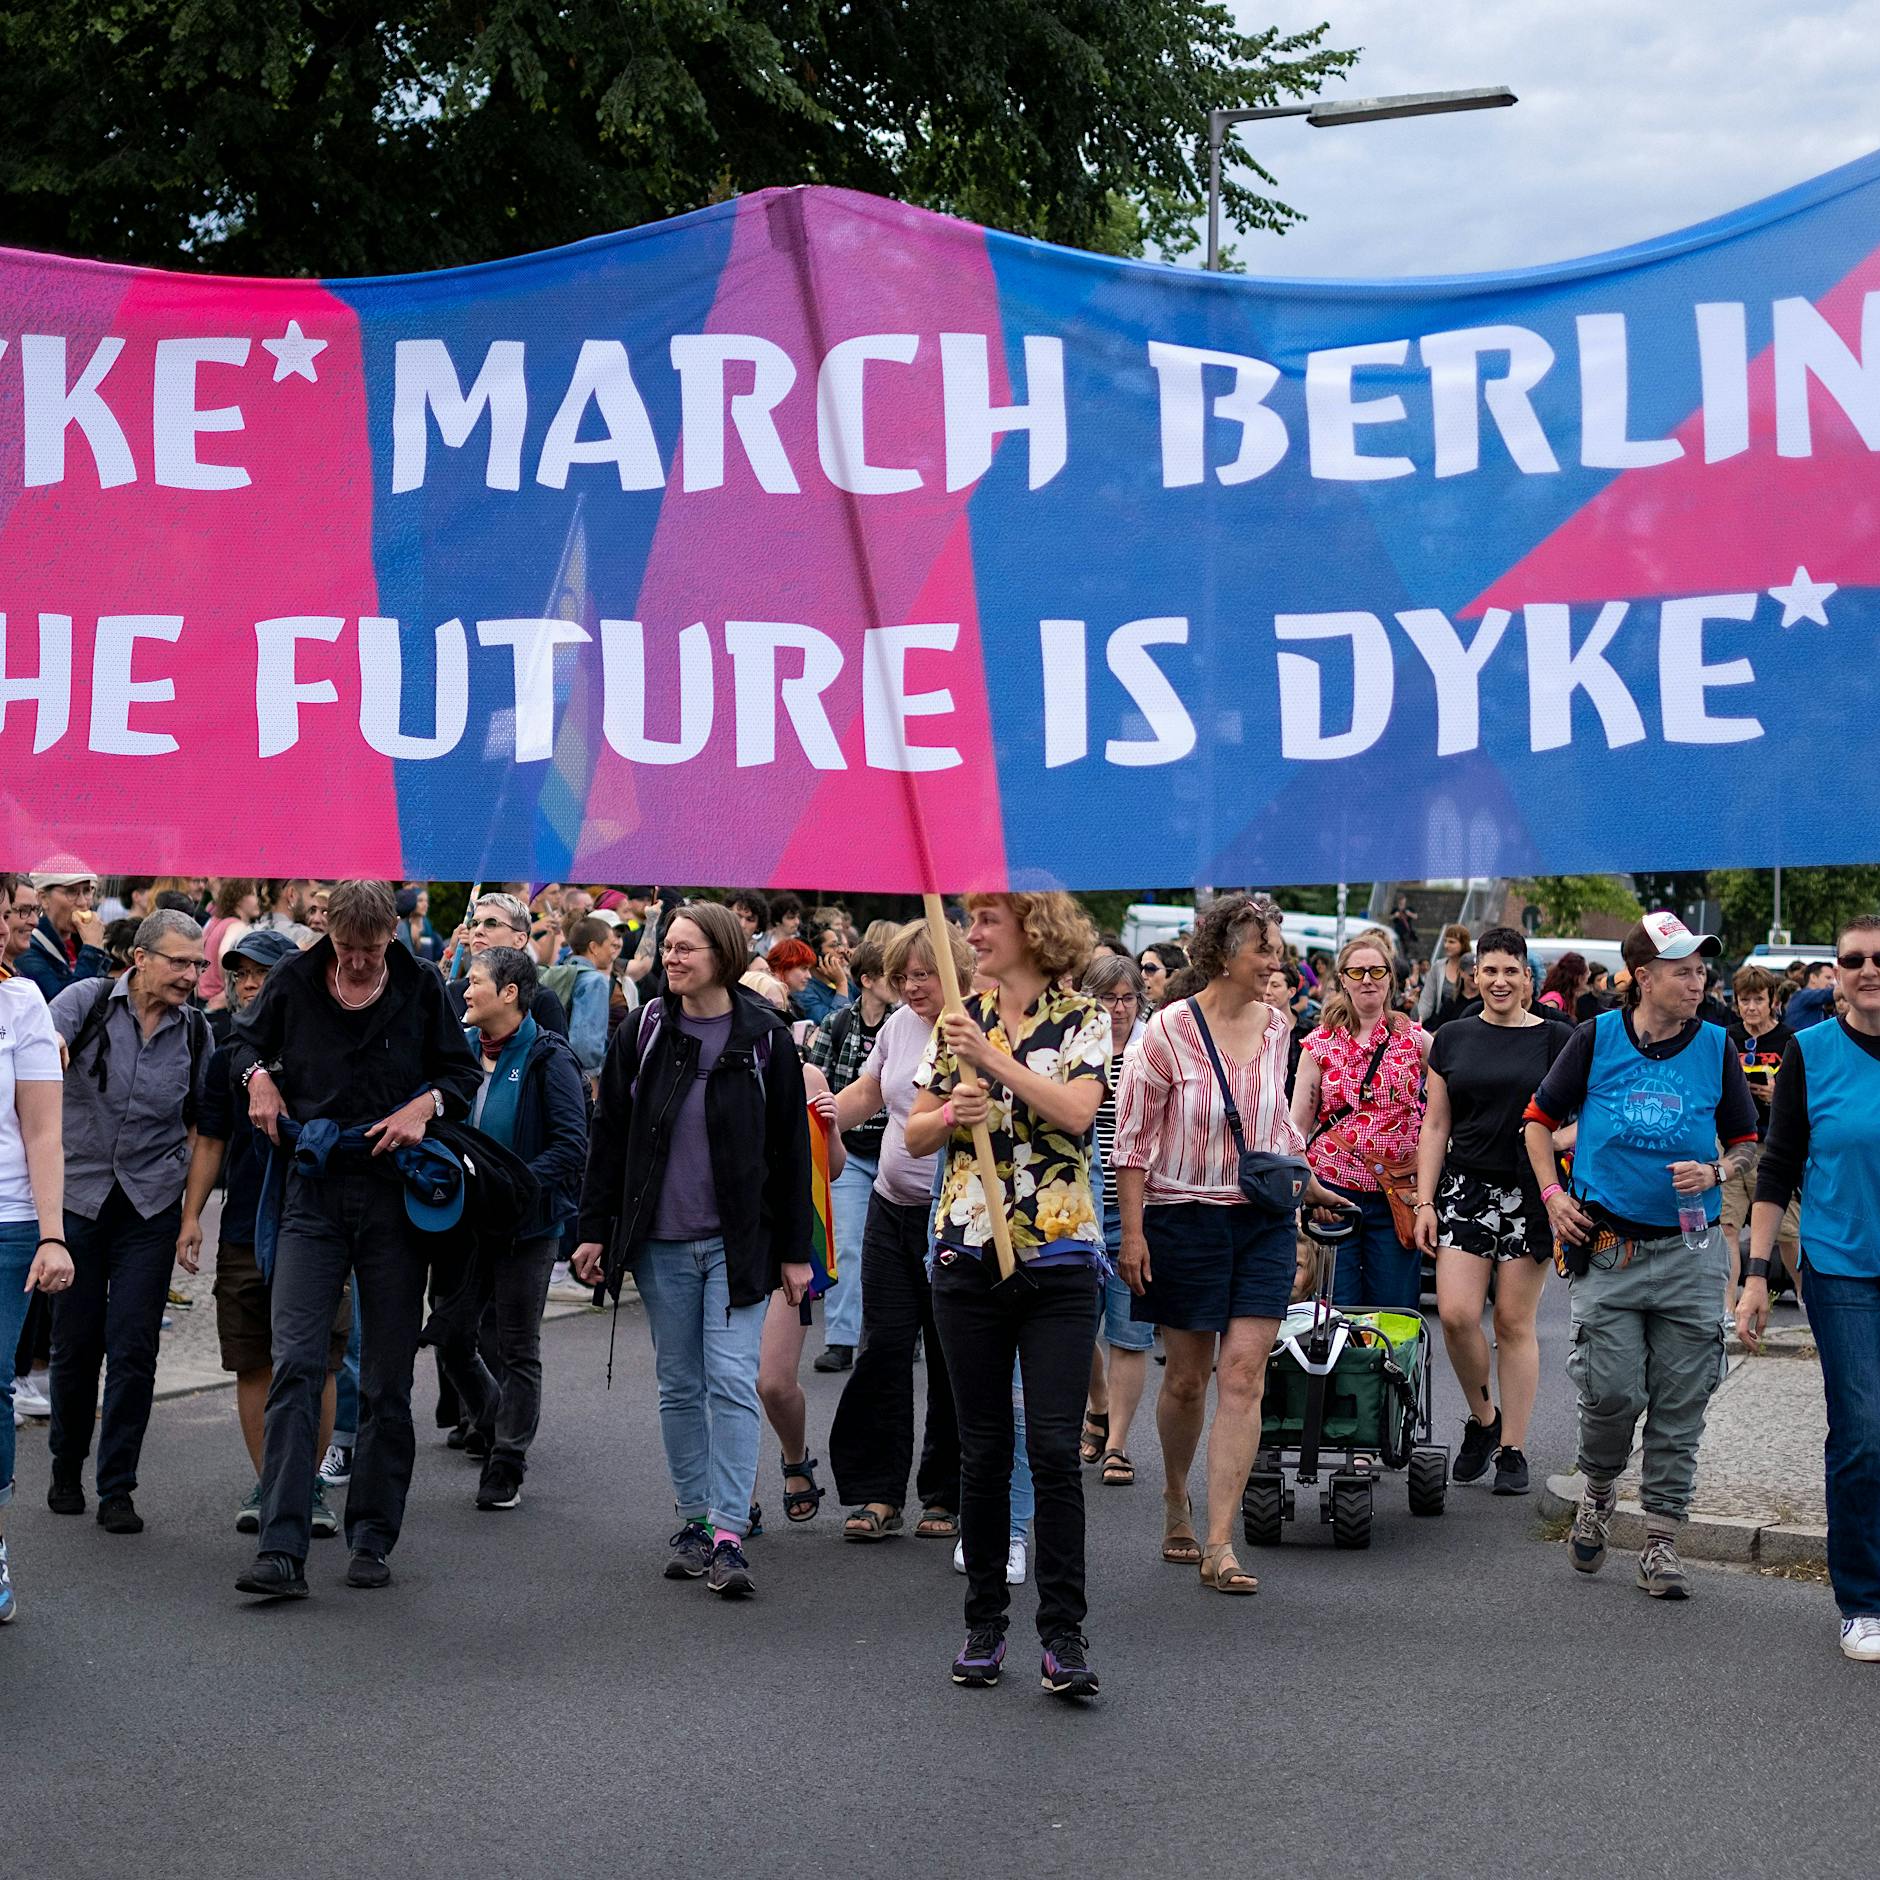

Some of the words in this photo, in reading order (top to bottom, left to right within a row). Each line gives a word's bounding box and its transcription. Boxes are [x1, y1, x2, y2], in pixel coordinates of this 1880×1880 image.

[392, 332, 1067, 495] MARCH
[1148, 292, 1880, 488] BERLIN
[254, 616, 963, 772] FUTURE
[1040, 616, 1197, 769] IS
[1609, 1113, 1691, 1149] SOLIDARITY
